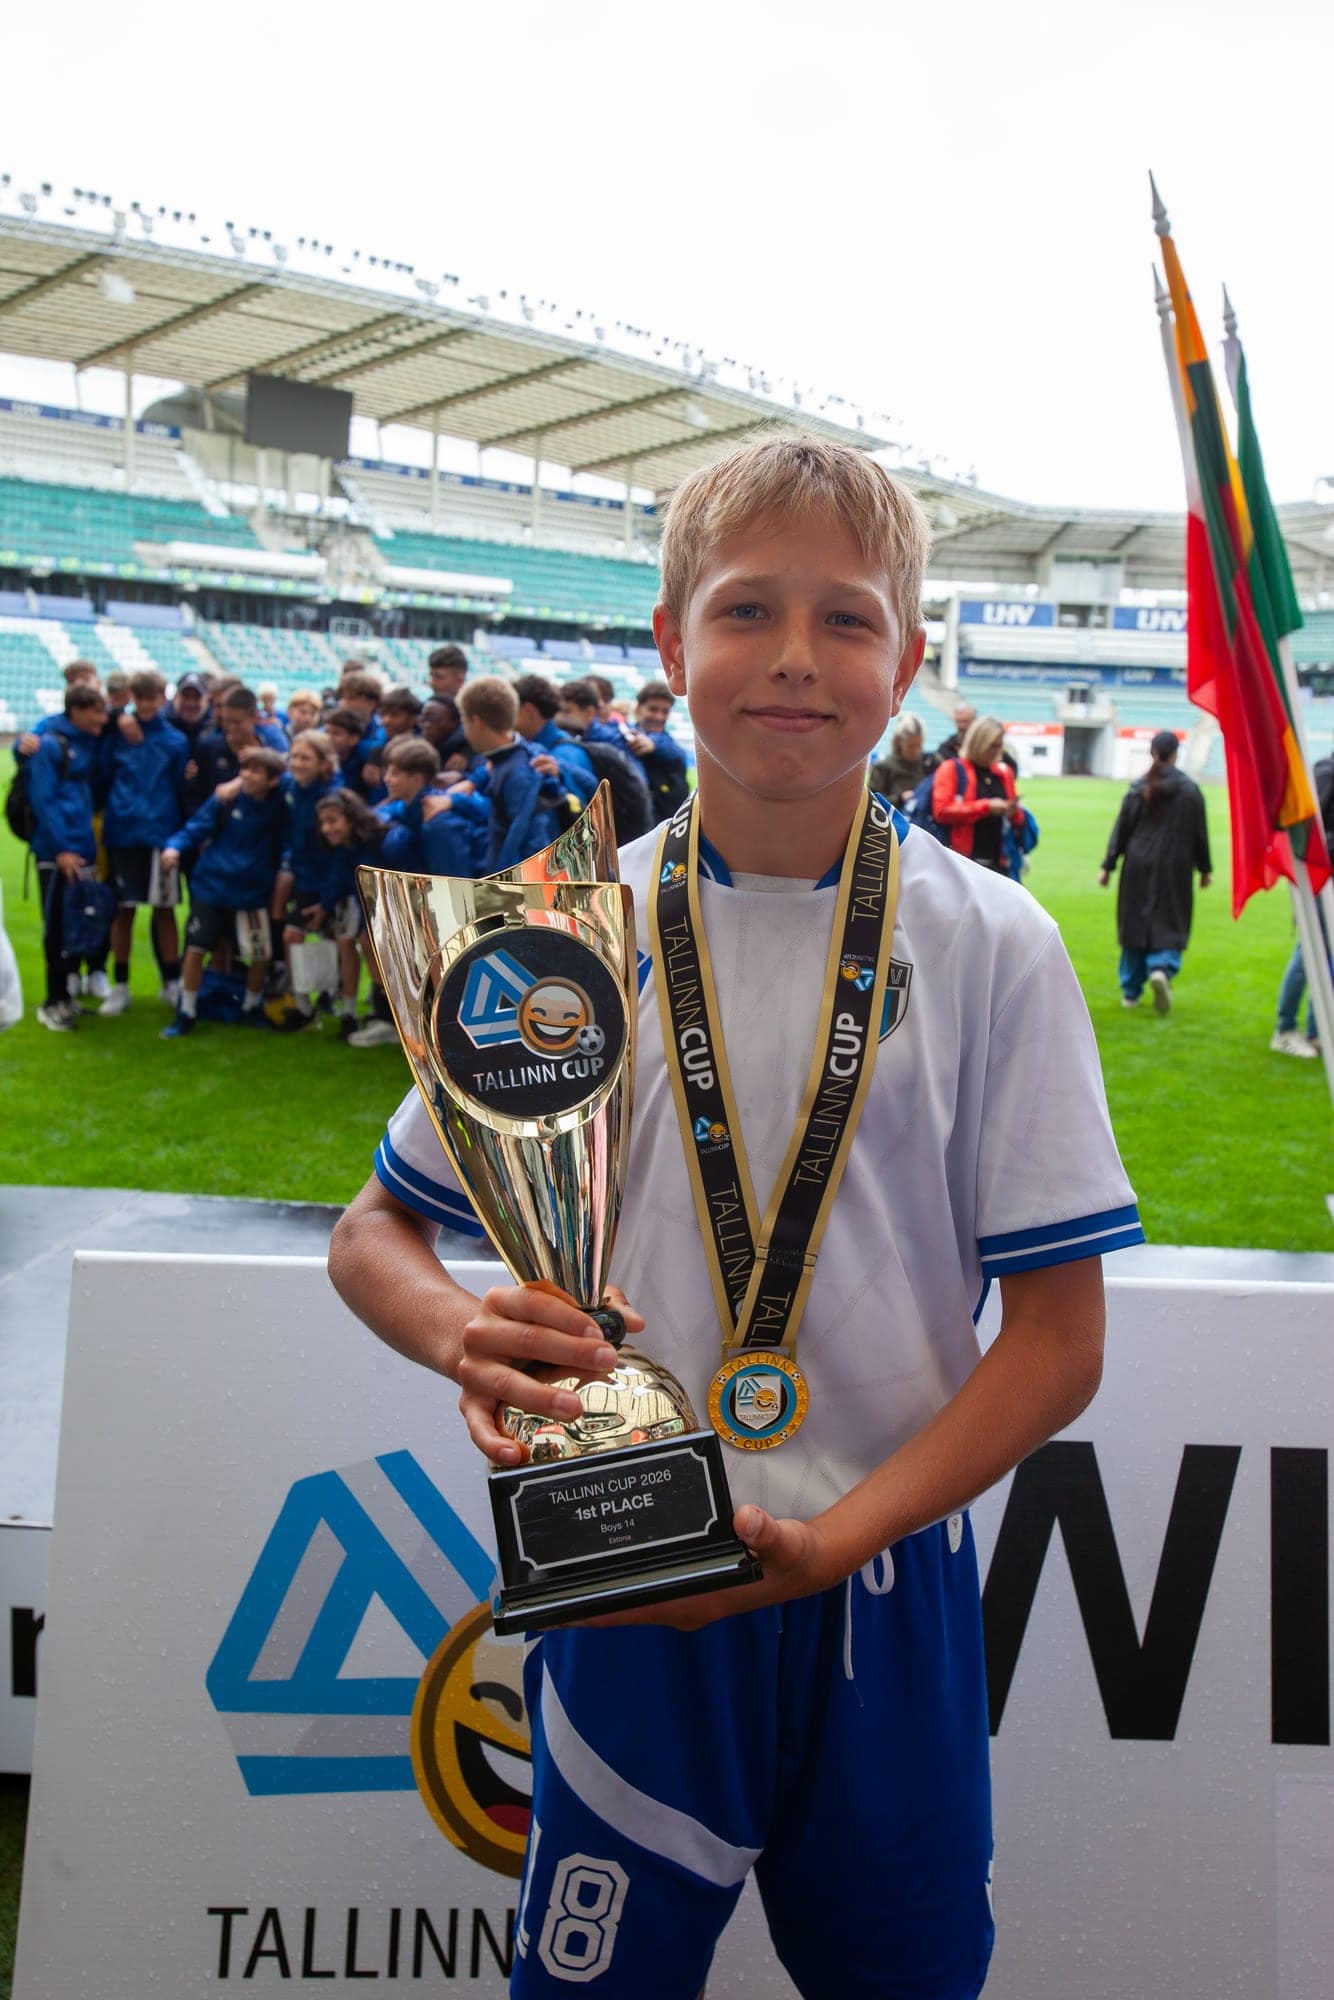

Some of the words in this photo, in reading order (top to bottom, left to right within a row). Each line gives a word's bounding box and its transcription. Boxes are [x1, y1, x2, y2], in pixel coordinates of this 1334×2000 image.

[472, 1063, 557, 1092] TALLINN
[561, 1057, 605, 1080] CUP
[743, 1438, 774, 1450] CUP
[548, 1482, 605, 1504] TALLINN
[607, 1476, 637, 1492] CUP
[640, 1469, 672, 1486] 2026
[576, 1505, 598, 1520] 1st
[600, 1493, 654, 1516] PLACE
[600, 1522, 623, 1533] Boys
[625, 1518, 635, 1528] 14
[207, 1907, 516, 1979] TALLINN
